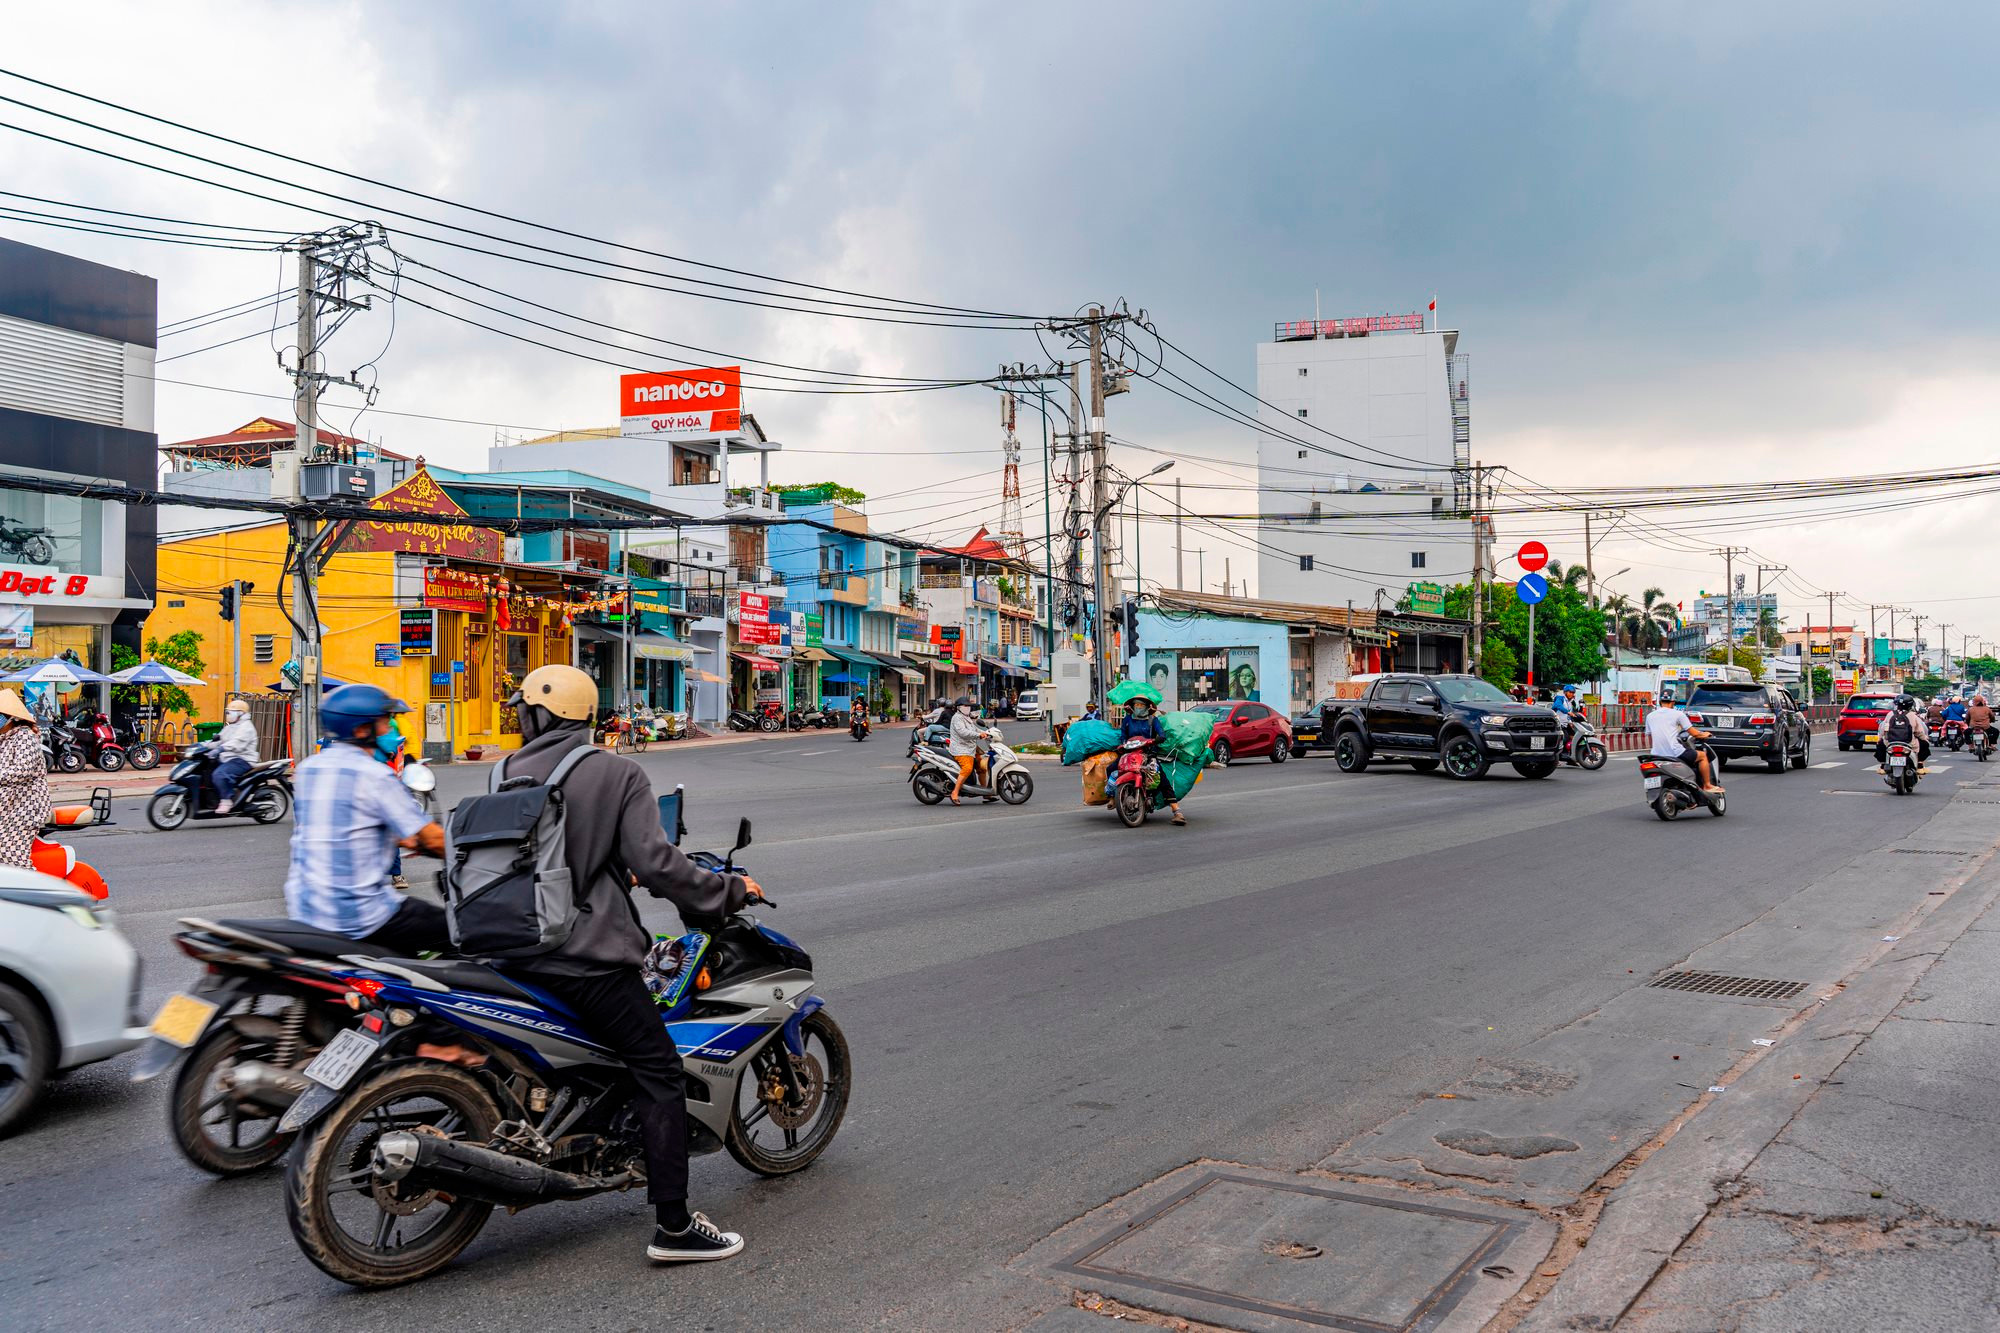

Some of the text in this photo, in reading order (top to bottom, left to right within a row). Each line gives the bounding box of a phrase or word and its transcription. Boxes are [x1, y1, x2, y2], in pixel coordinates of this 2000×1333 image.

[634, 380, 726, 403] nanoco
[651, 415, 701, 431] QUÝ HÓA
[64, 575, 89, 596] 8
[453, 1000, 567, 1033] EXCITER GP
[700, 1046, 738, 1058] 150
[700, 1063, 735, 1079] YAMAHA
